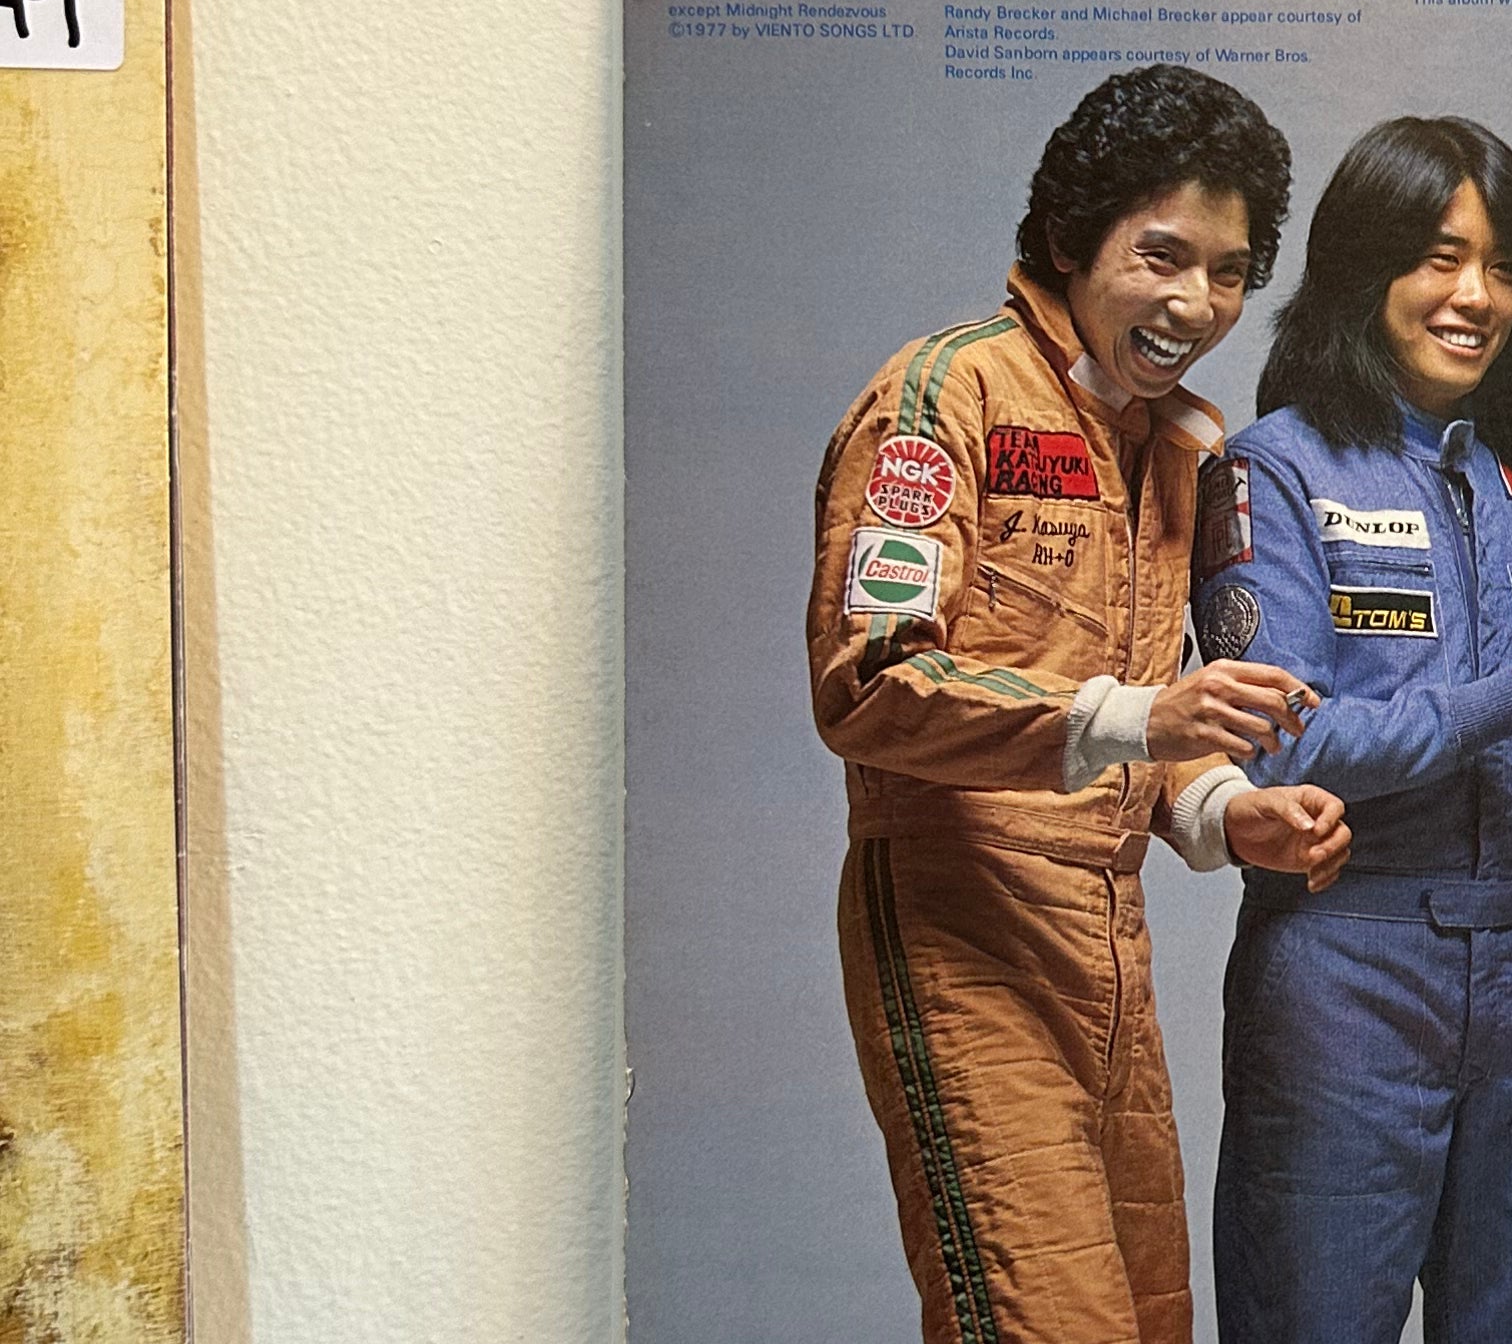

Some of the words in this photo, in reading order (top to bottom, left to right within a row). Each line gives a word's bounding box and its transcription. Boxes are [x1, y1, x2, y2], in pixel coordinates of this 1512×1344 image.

[668, 5, 720, 19] except
[727, 4, 793, 19] Midnight
[799, 5, 886, 18] Rendezvous
[732, 24, 750, 40] by
[756, 24, 815, 37] VIENTO
[820, 24, 877, 38] SONGS
[880, 455, 940, 487] NGK
[878, 482, 934, 503] SPARK
[876, 495, 932, 517] PLUGS
[1324, 511, 1420, 537] DUNLOP
[865, 560, 929, 584] Castrol
[1352, 610, 1427, 631] TOM'S
